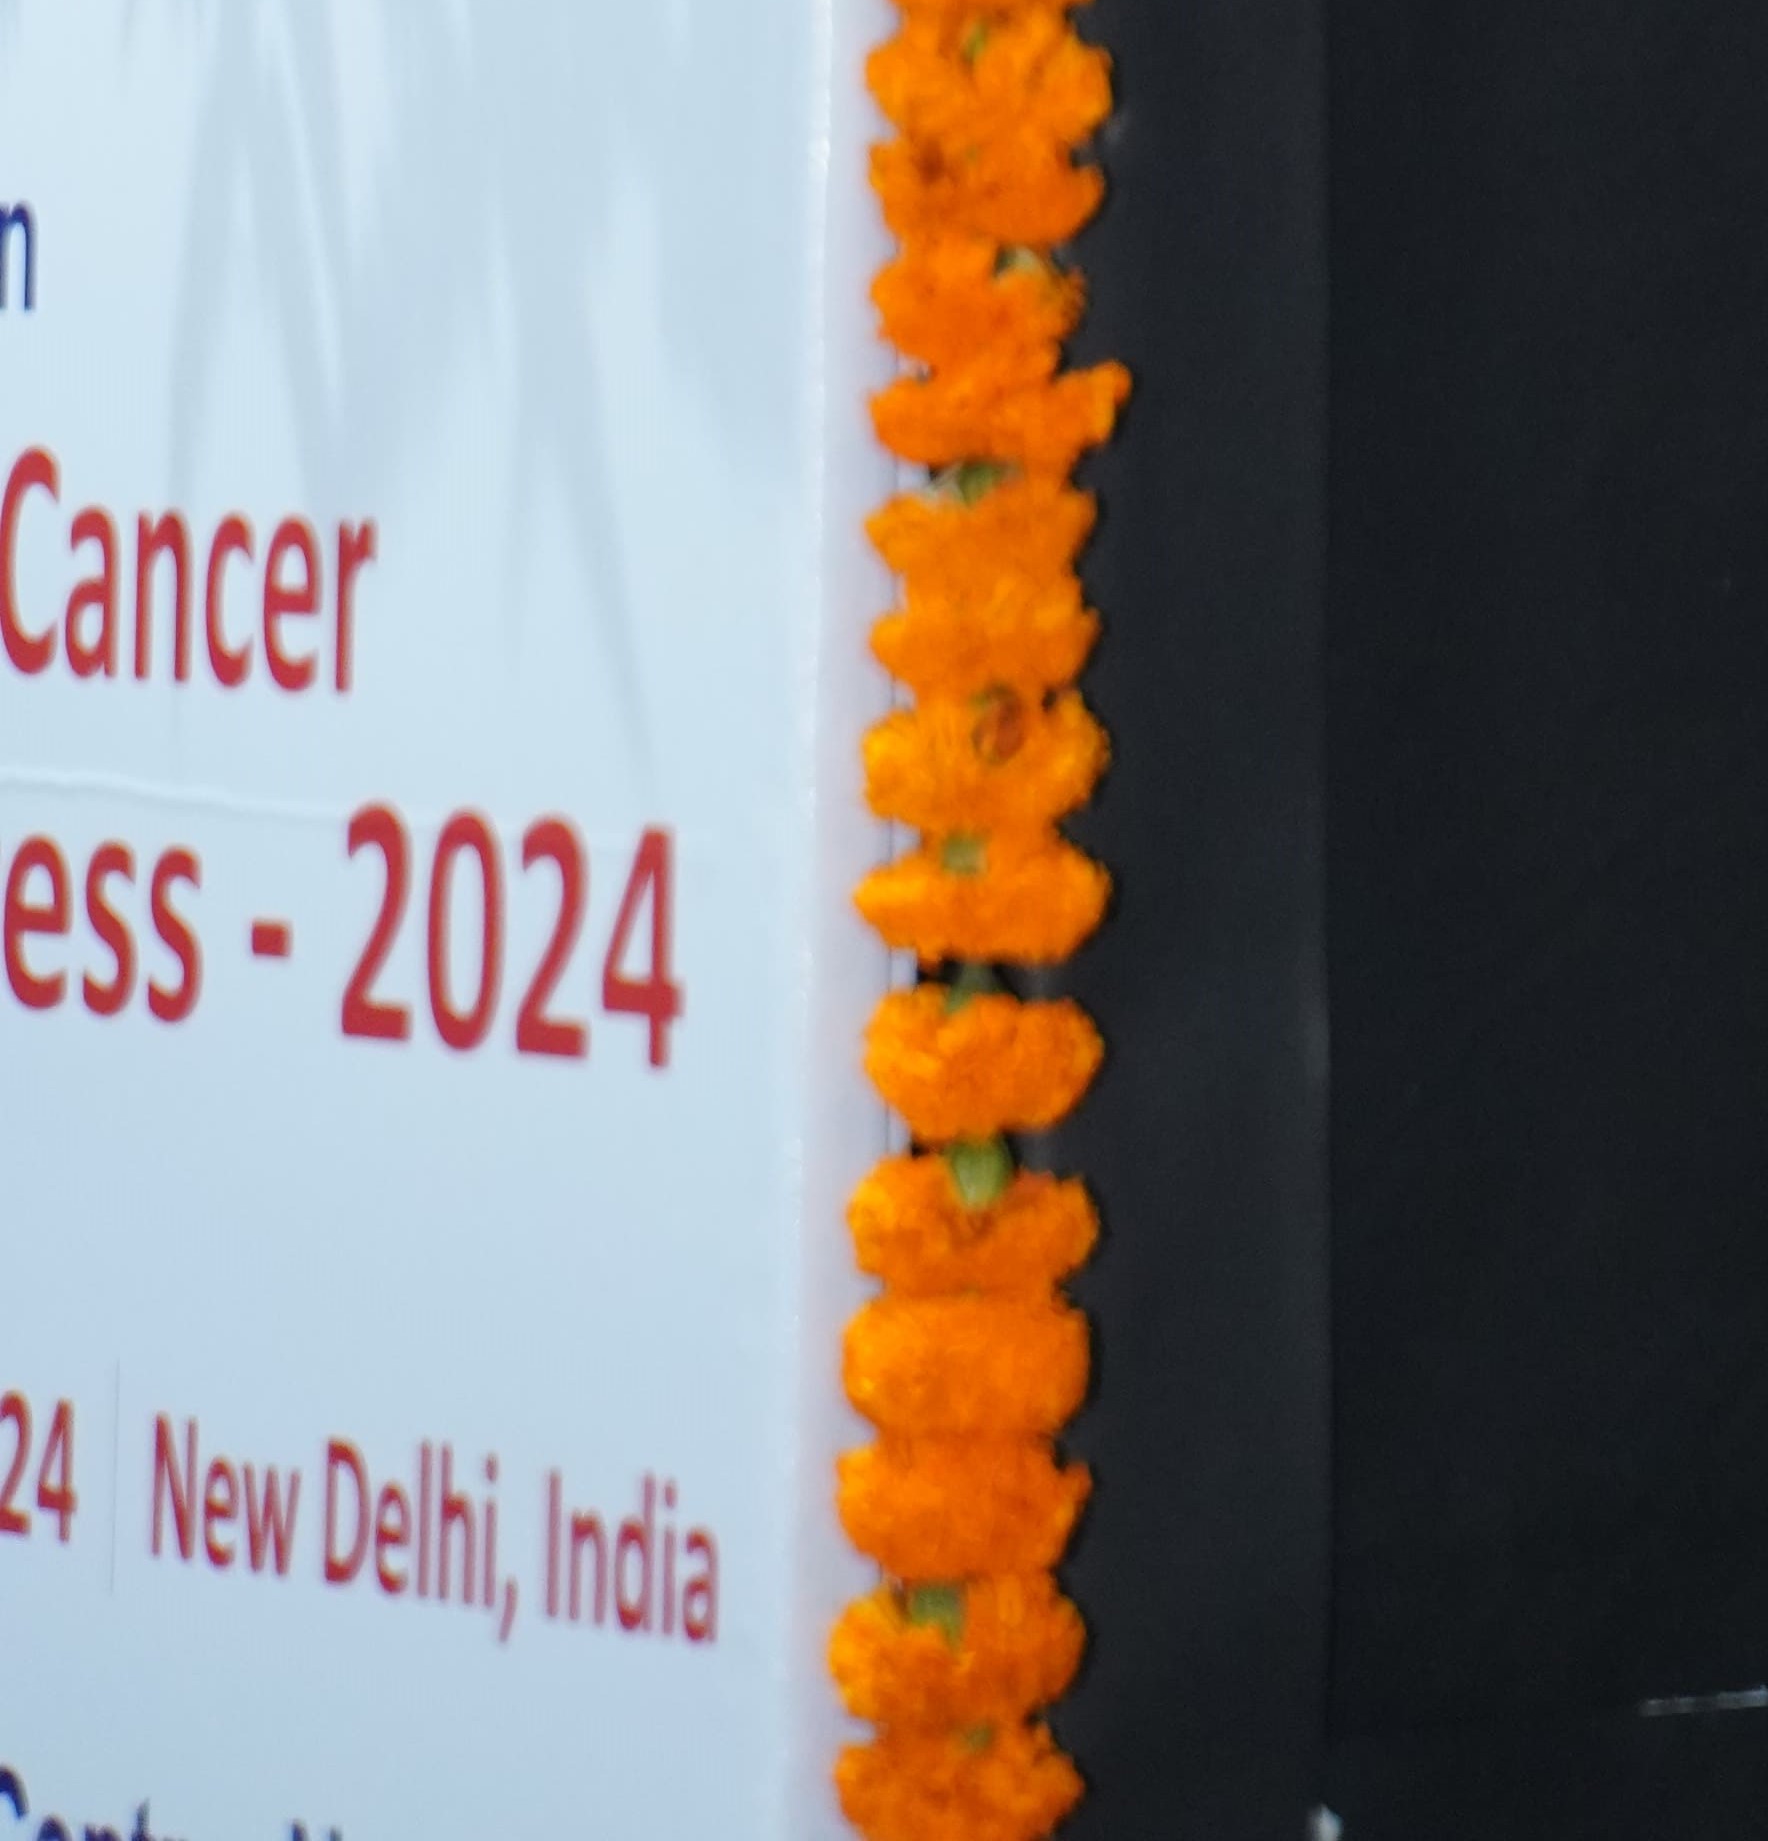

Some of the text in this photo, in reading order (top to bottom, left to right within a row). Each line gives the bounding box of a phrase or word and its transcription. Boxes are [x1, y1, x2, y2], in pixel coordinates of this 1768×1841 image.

[0, 446, 377, 693] Cancer
[2, 835, 202, 1024] ess
[340, 803, 683, 1069] 2024
[0, 1390, 717, 1644] 24 New Delhi, India
